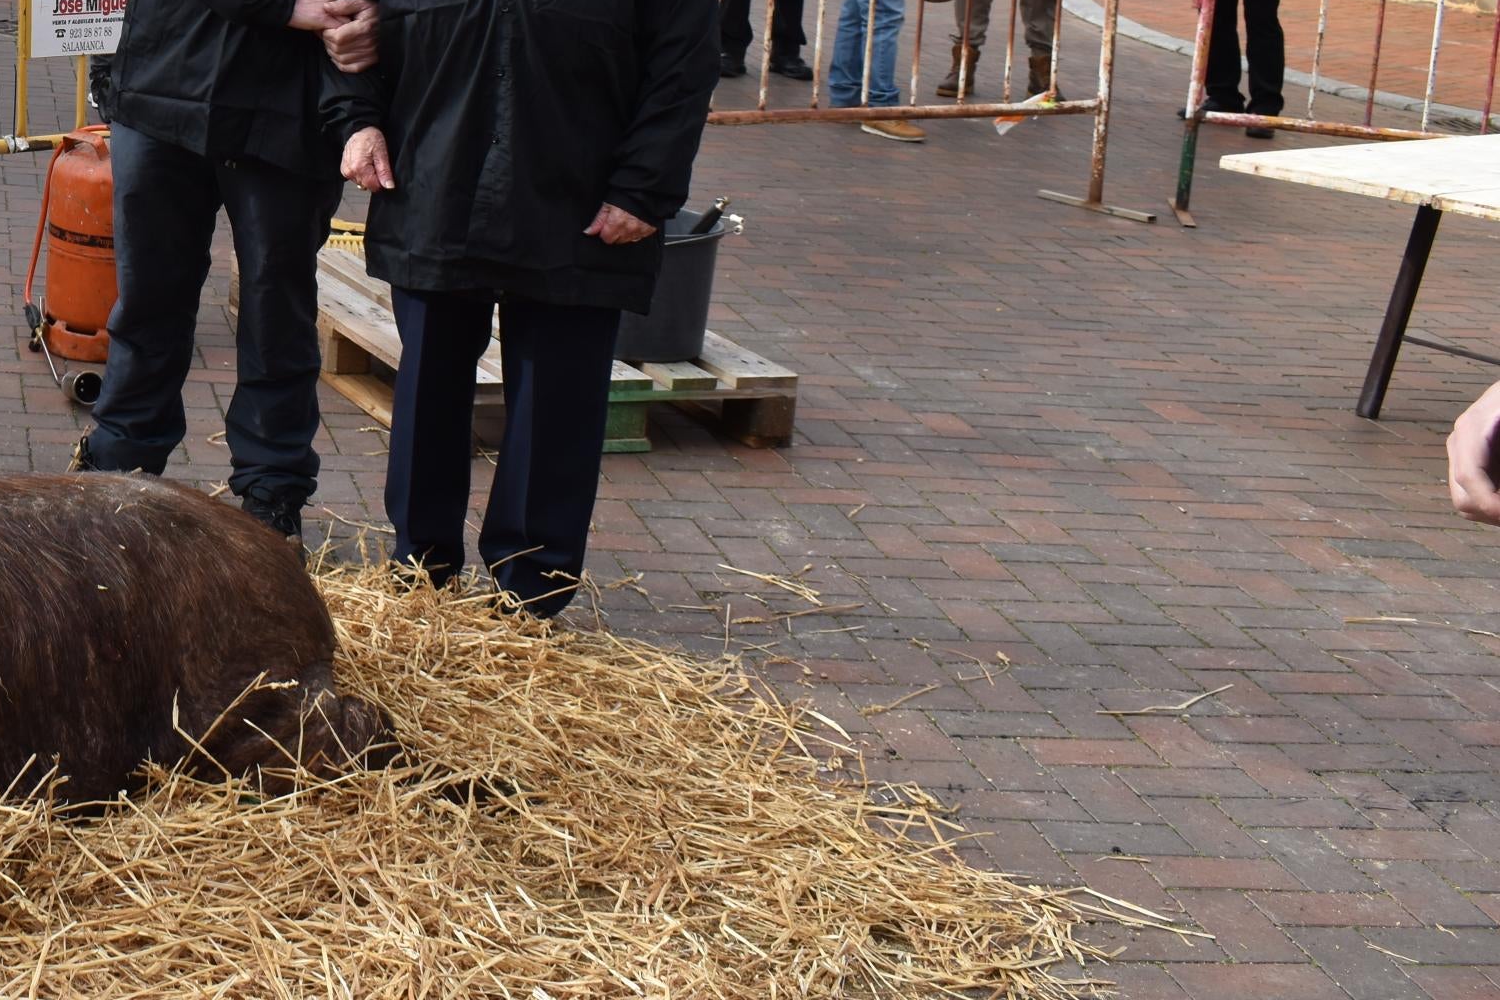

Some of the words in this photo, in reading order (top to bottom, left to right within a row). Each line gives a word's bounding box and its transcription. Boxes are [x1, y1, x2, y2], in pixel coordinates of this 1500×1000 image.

[69, 28, 82, 38] 923
[83, 28, 92, 37] 28
[62, 40, 105, 52] SALAMANCA
